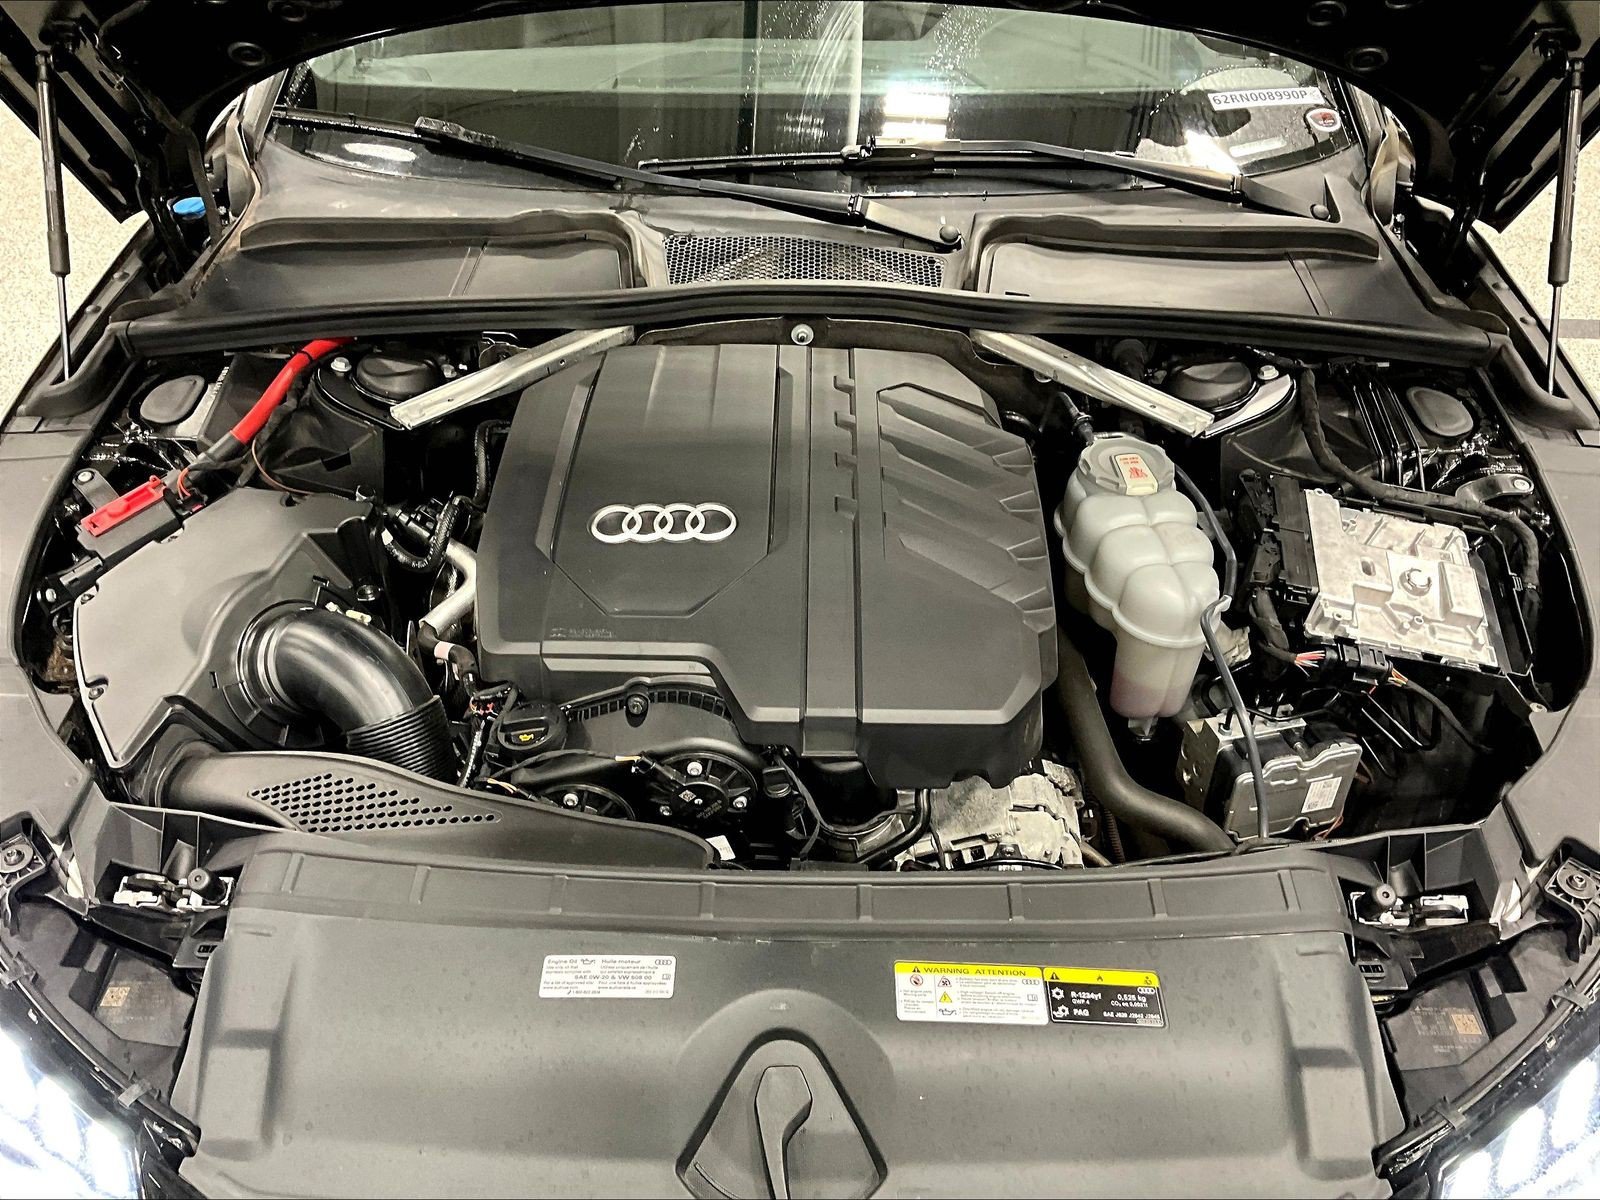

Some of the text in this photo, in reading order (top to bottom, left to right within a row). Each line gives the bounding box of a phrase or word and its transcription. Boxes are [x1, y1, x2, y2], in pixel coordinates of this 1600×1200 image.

[1212, 90, 1308, 105] 62RN008990P
[924, 967, 970, 975] WARNING
[1138, 994, 1147, 1003] kg
[1073, 1008, 1090, 1017] PAG
